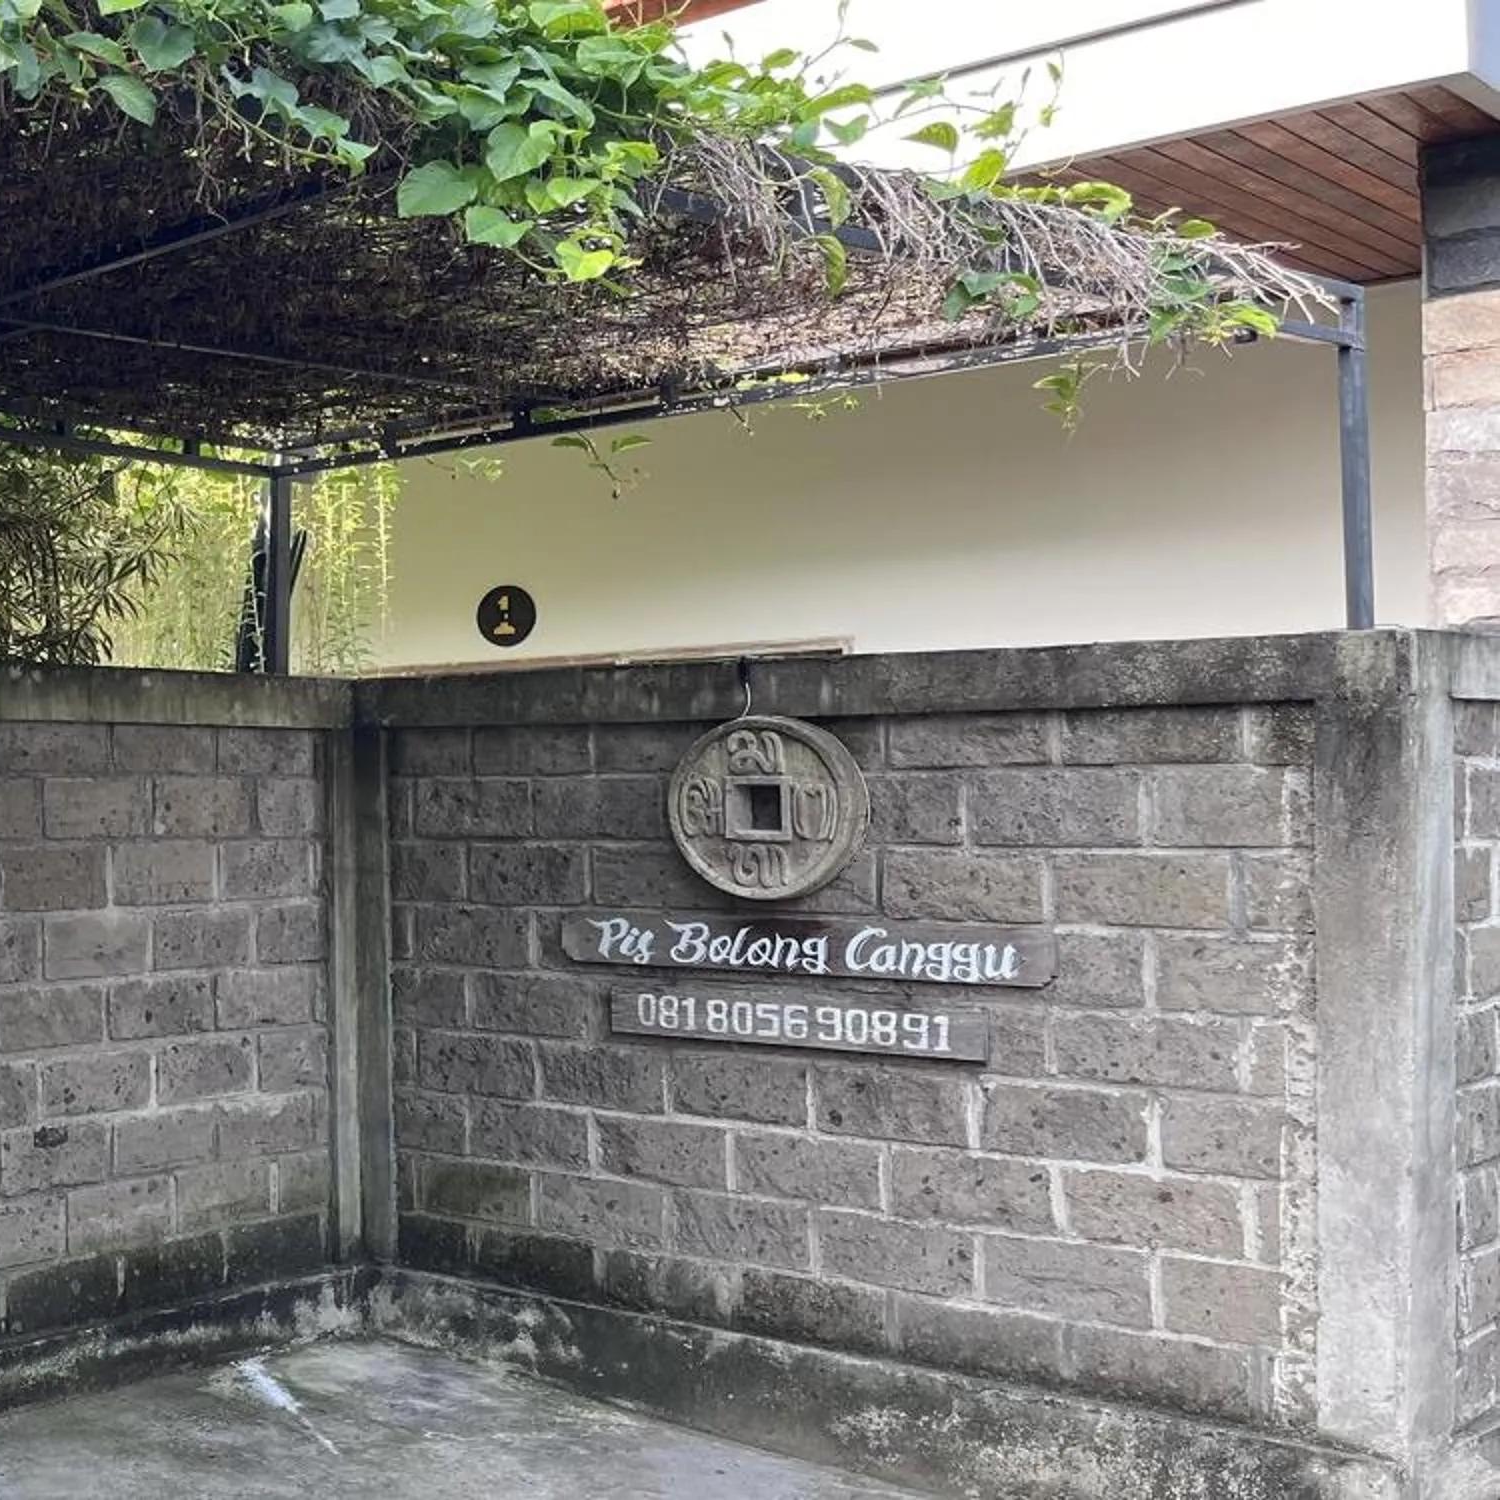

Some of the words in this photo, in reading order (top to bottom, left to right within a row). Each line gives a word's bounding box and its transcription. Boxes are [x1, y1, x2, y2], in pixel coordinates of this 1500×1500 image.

[585, 917, 654, 964] Pis
[663, 919, 831, 974] Bolong
[845, 925, 1025, 982] Canggu
